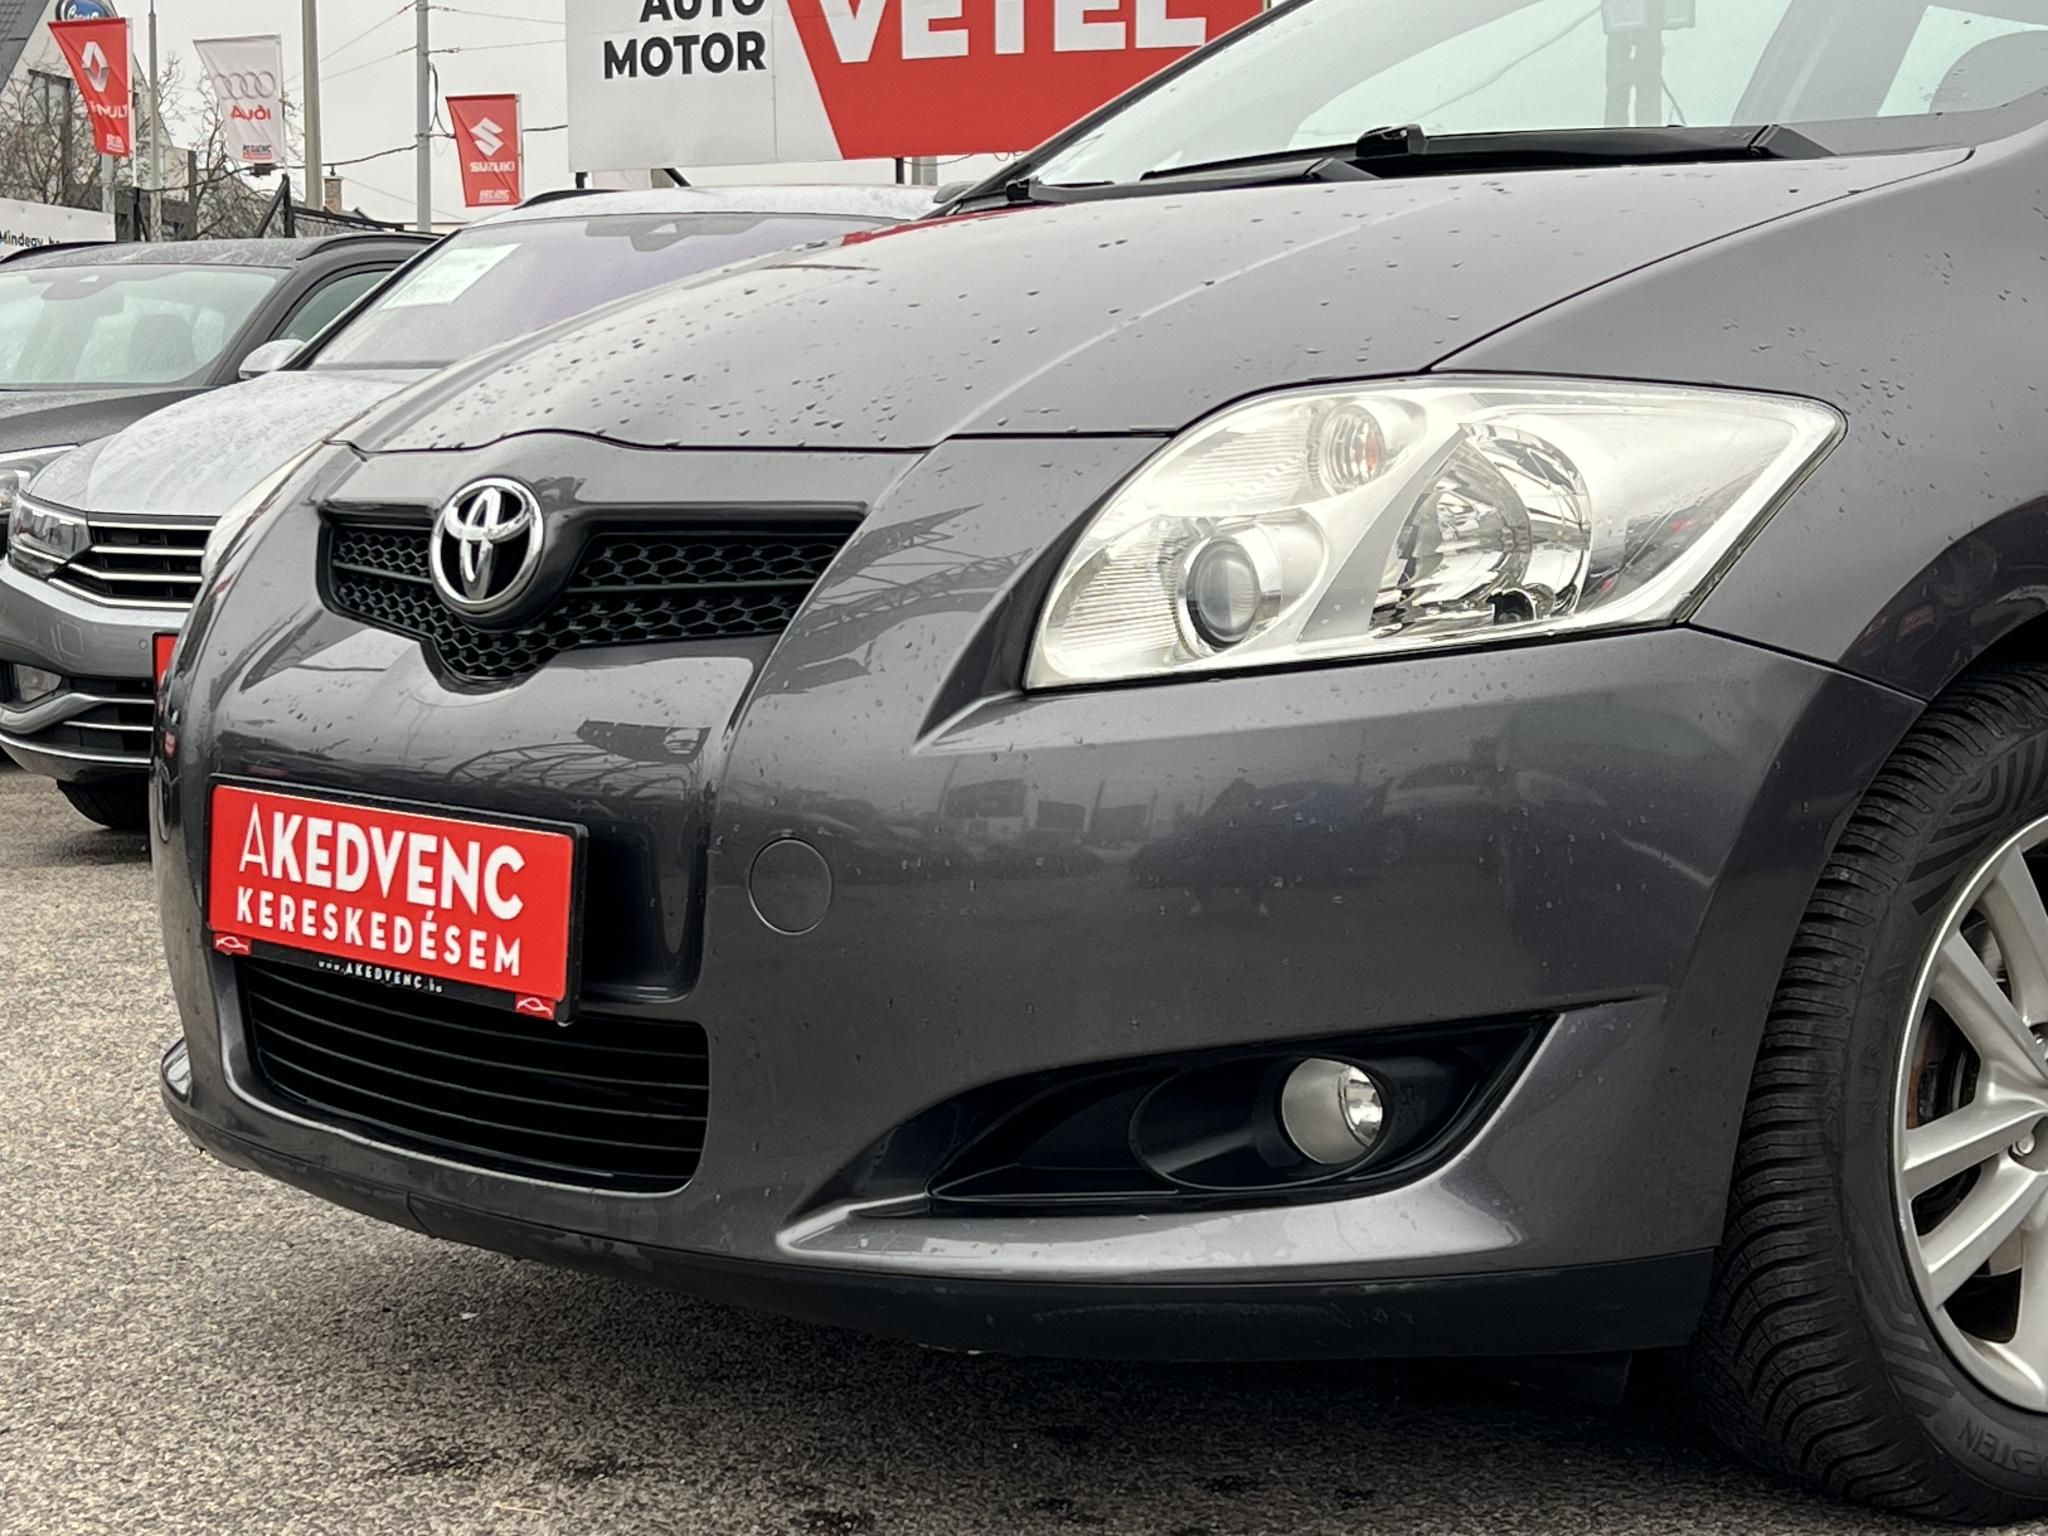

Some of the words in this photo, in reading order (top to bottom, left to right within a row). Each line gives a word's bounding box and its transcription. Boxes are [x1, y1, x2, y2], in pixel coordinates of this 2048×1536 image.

[603, 31, 767, 80] MOTOR
[469, 160, 516, 173] SUZUKI
[238, 802, 526, 920] AKEDVENC
[236, 885, 521, 977] KERESKEDÉSEM
